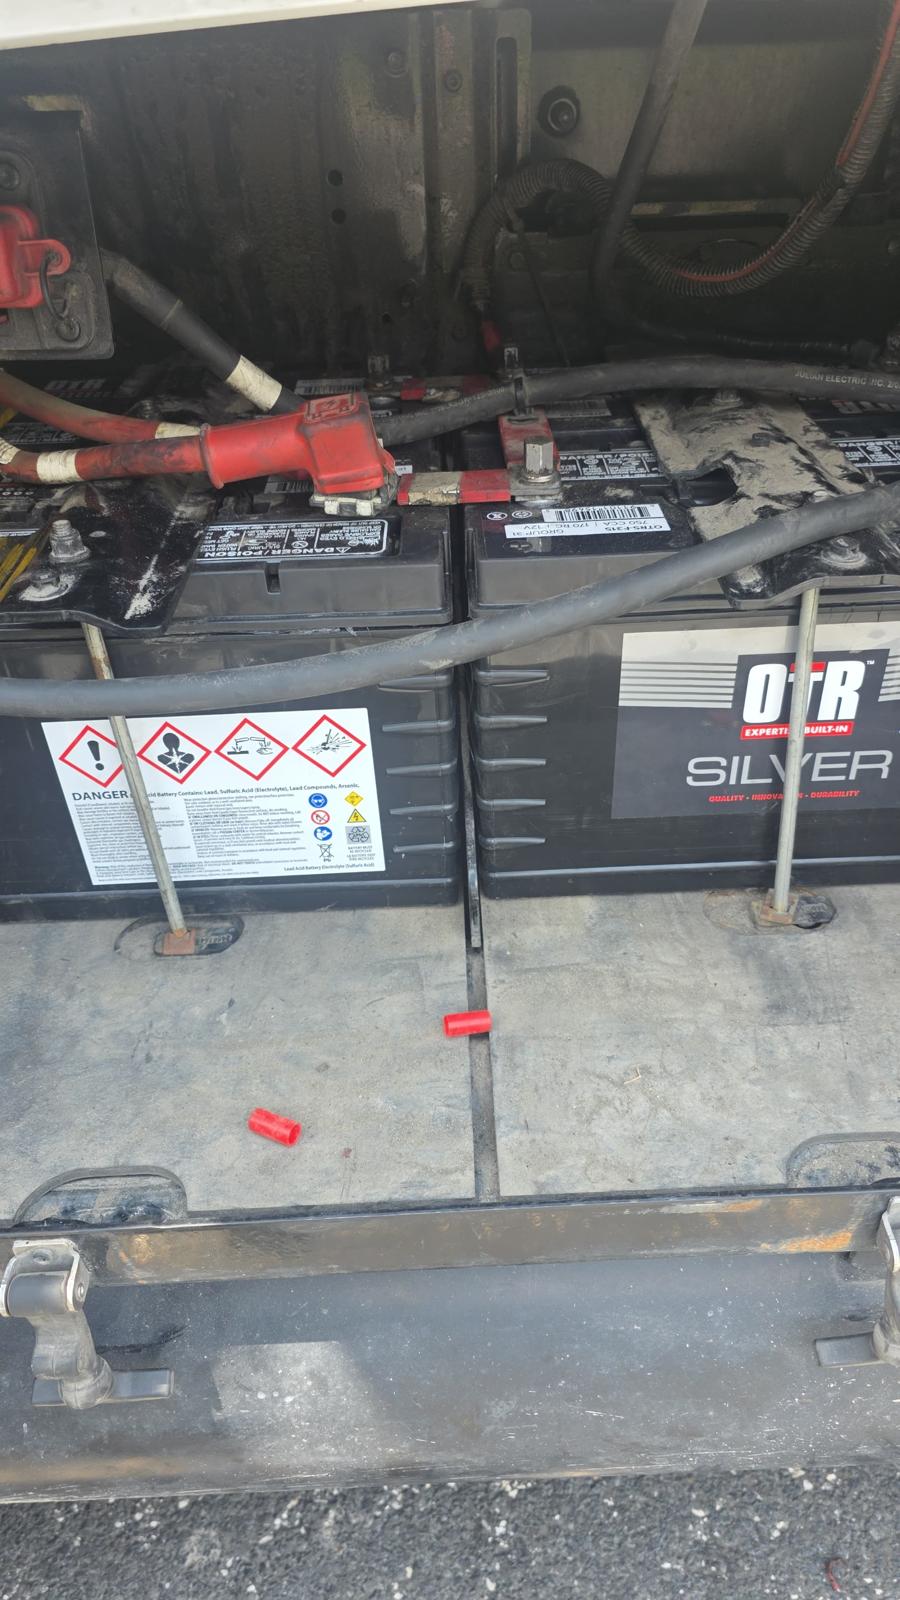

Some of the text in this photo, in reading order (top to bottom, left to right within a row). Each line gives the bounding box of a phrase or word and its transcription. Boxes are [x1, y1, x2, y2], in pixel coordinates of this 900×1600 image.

[825, 375, 867, 385] ELECTRIC
[742, 660, 866, 724] OTR
[803, 724, 848, 735] BUILT-IN
[686, 749, 893, 787] SILVER
[71, 790, 129, 801] DANGER
[156, 790, 177, 799] Battery
[219, 787, 241, 795] Sulfuric
[289, 784, 303, 792] Lead
[708, 794, 745, 803] QUALITY
[810, 789, 860, 799] DURABILITY
